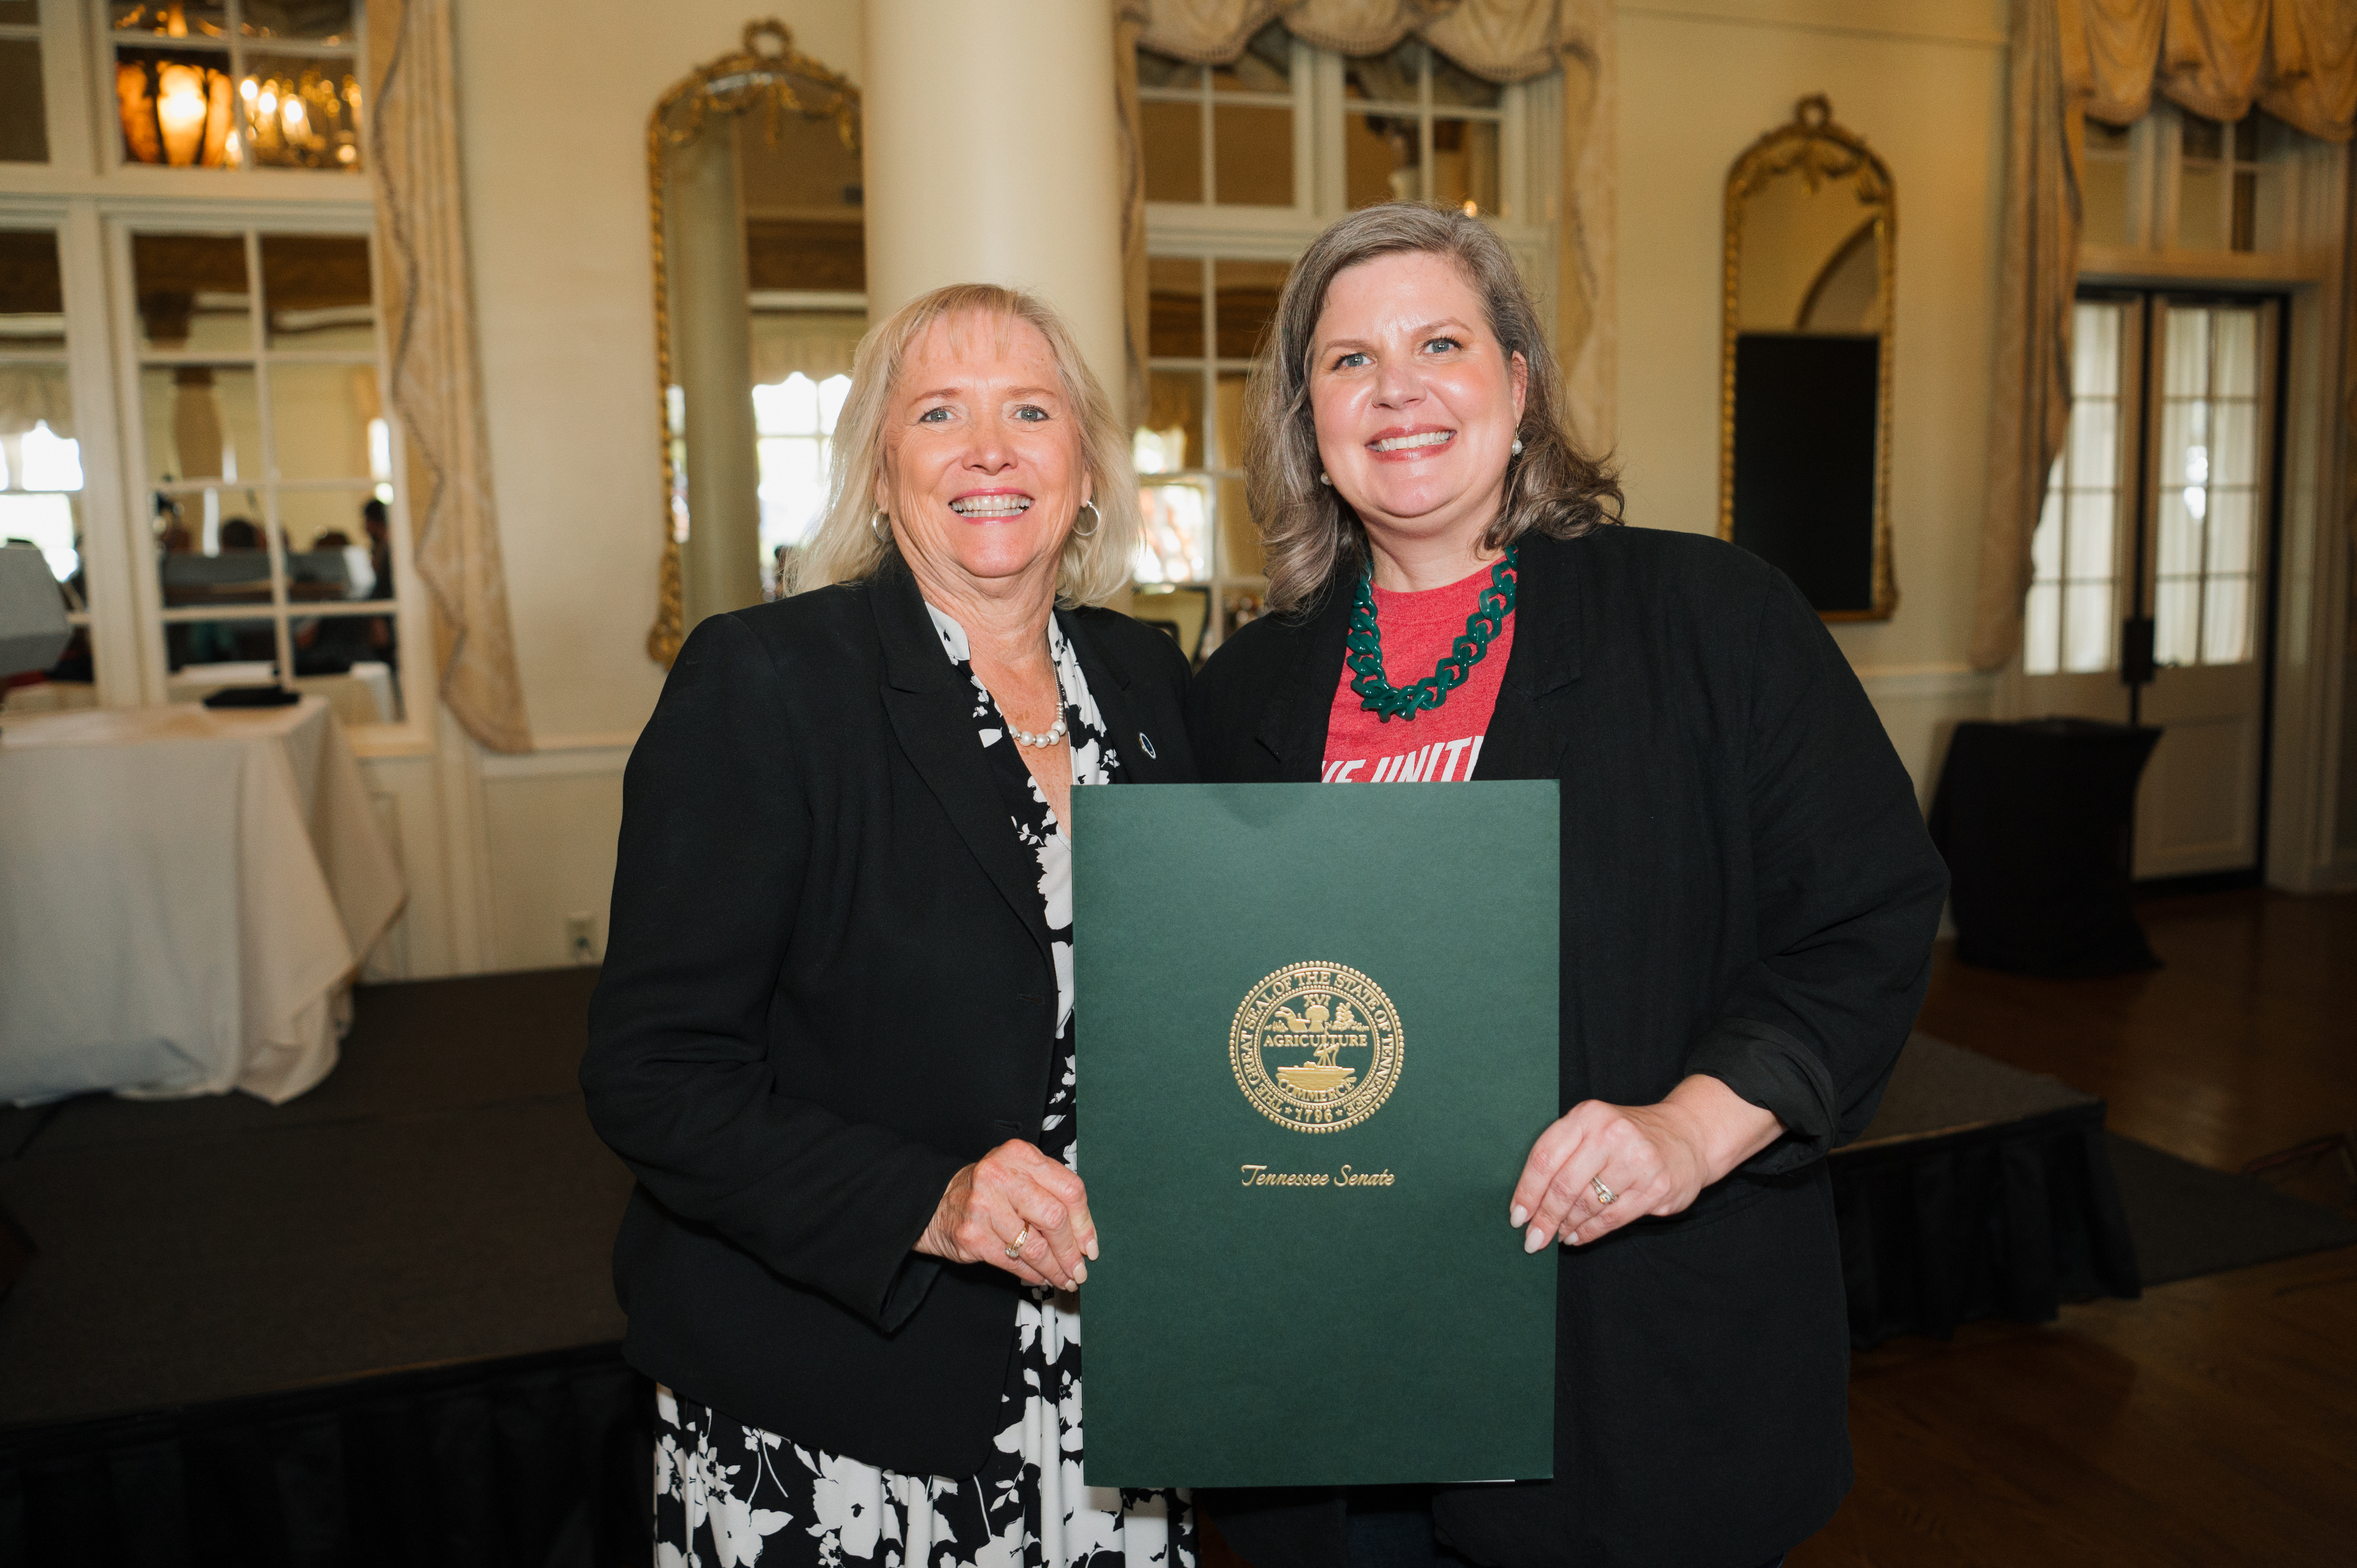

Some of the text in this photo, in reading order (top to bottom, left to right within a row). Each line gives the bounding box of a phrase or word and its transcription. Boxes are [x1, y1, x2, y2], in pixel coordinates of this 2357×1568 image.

[1303, 994, 1331, 1008] XVI
[1240, 971, 1394, 1116] THE GREAT SEAL OF THE STATE OF TENNESSEE
[1263, 1034, 1368, 1047] AGRICULTURE
[1278, 1078, 1355, 1102] COMMERCE
[1295, 1108, 1333, 1123] 1796
[1241, 1164, 1395, 1187] Tennessee Senate
